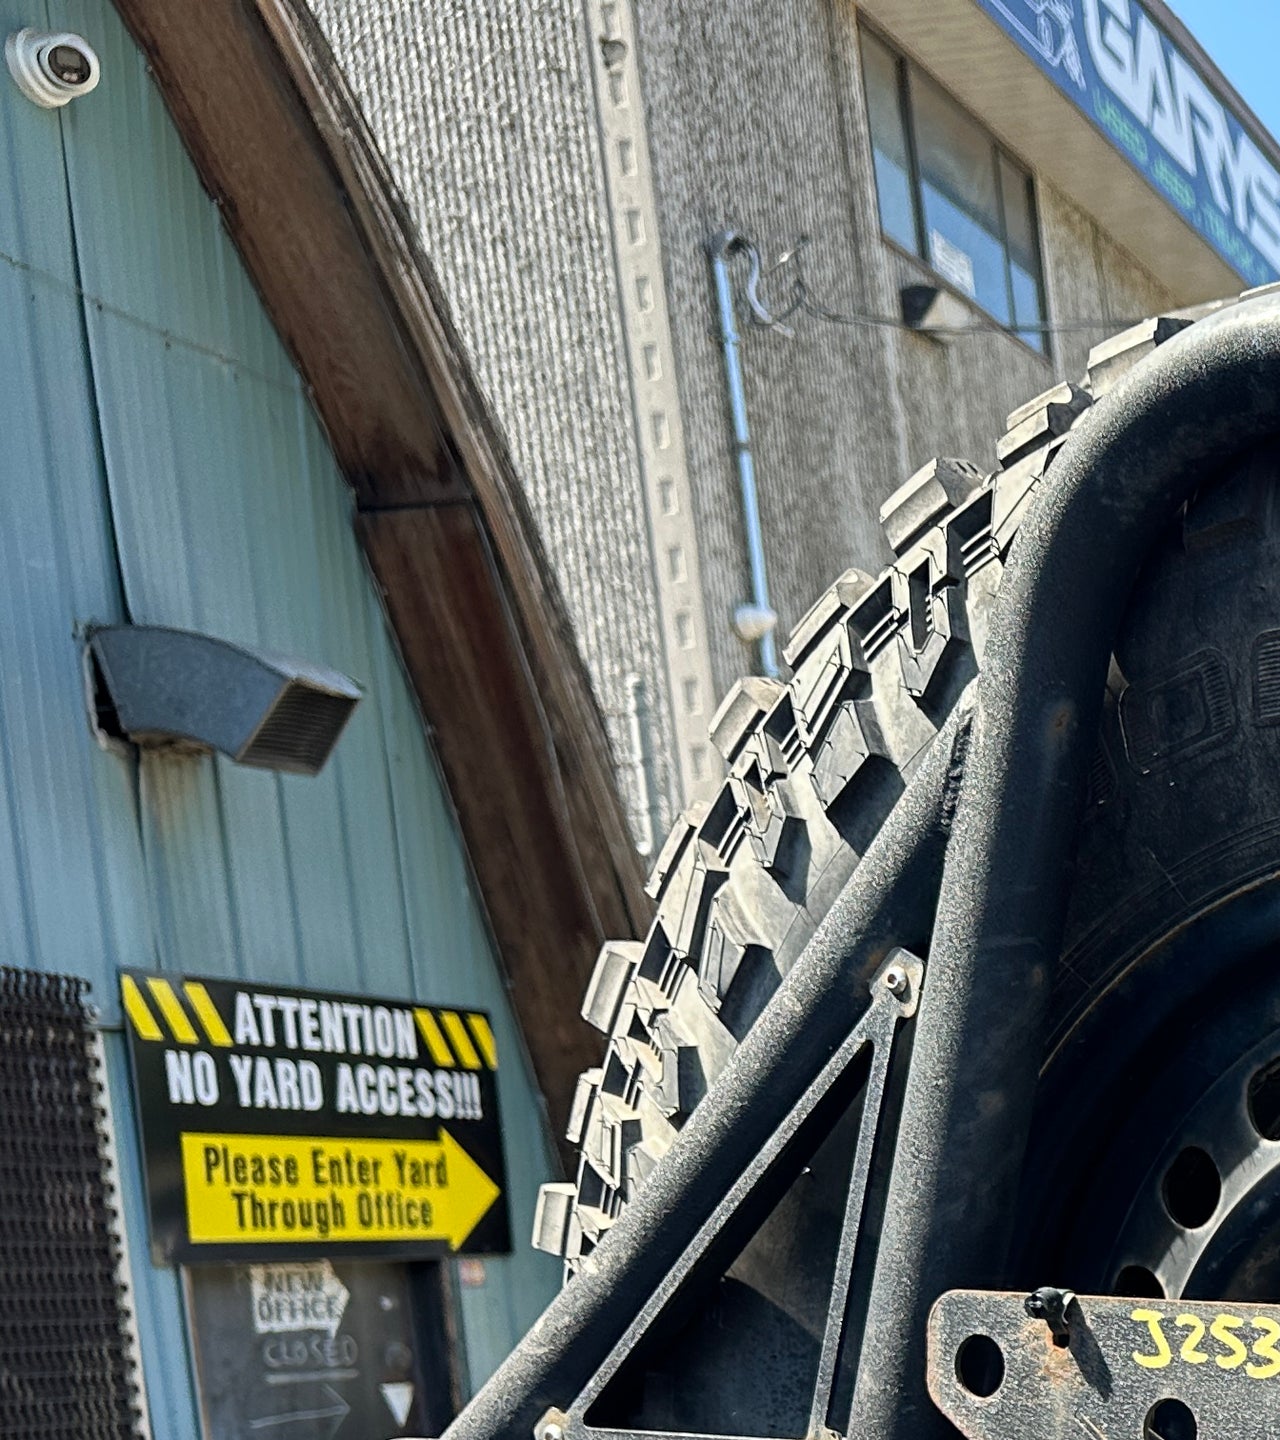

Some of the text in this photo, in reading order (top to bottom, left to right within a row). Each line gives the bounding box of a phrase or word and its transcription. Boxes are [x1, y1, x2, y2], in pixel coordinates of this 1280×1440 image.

[233, 991, 418, 1060] ATTENTION
[164, 1049, 483, 1120] NO YARD ACCESS!!!
[203, 1146, 449, 1189] Please Enter Yard
[230, 1192, 434, 1238] Through Office
[258, 1293, 339, 1321] OFFICE
[262, 1333, 359, 1368] CLOSED
